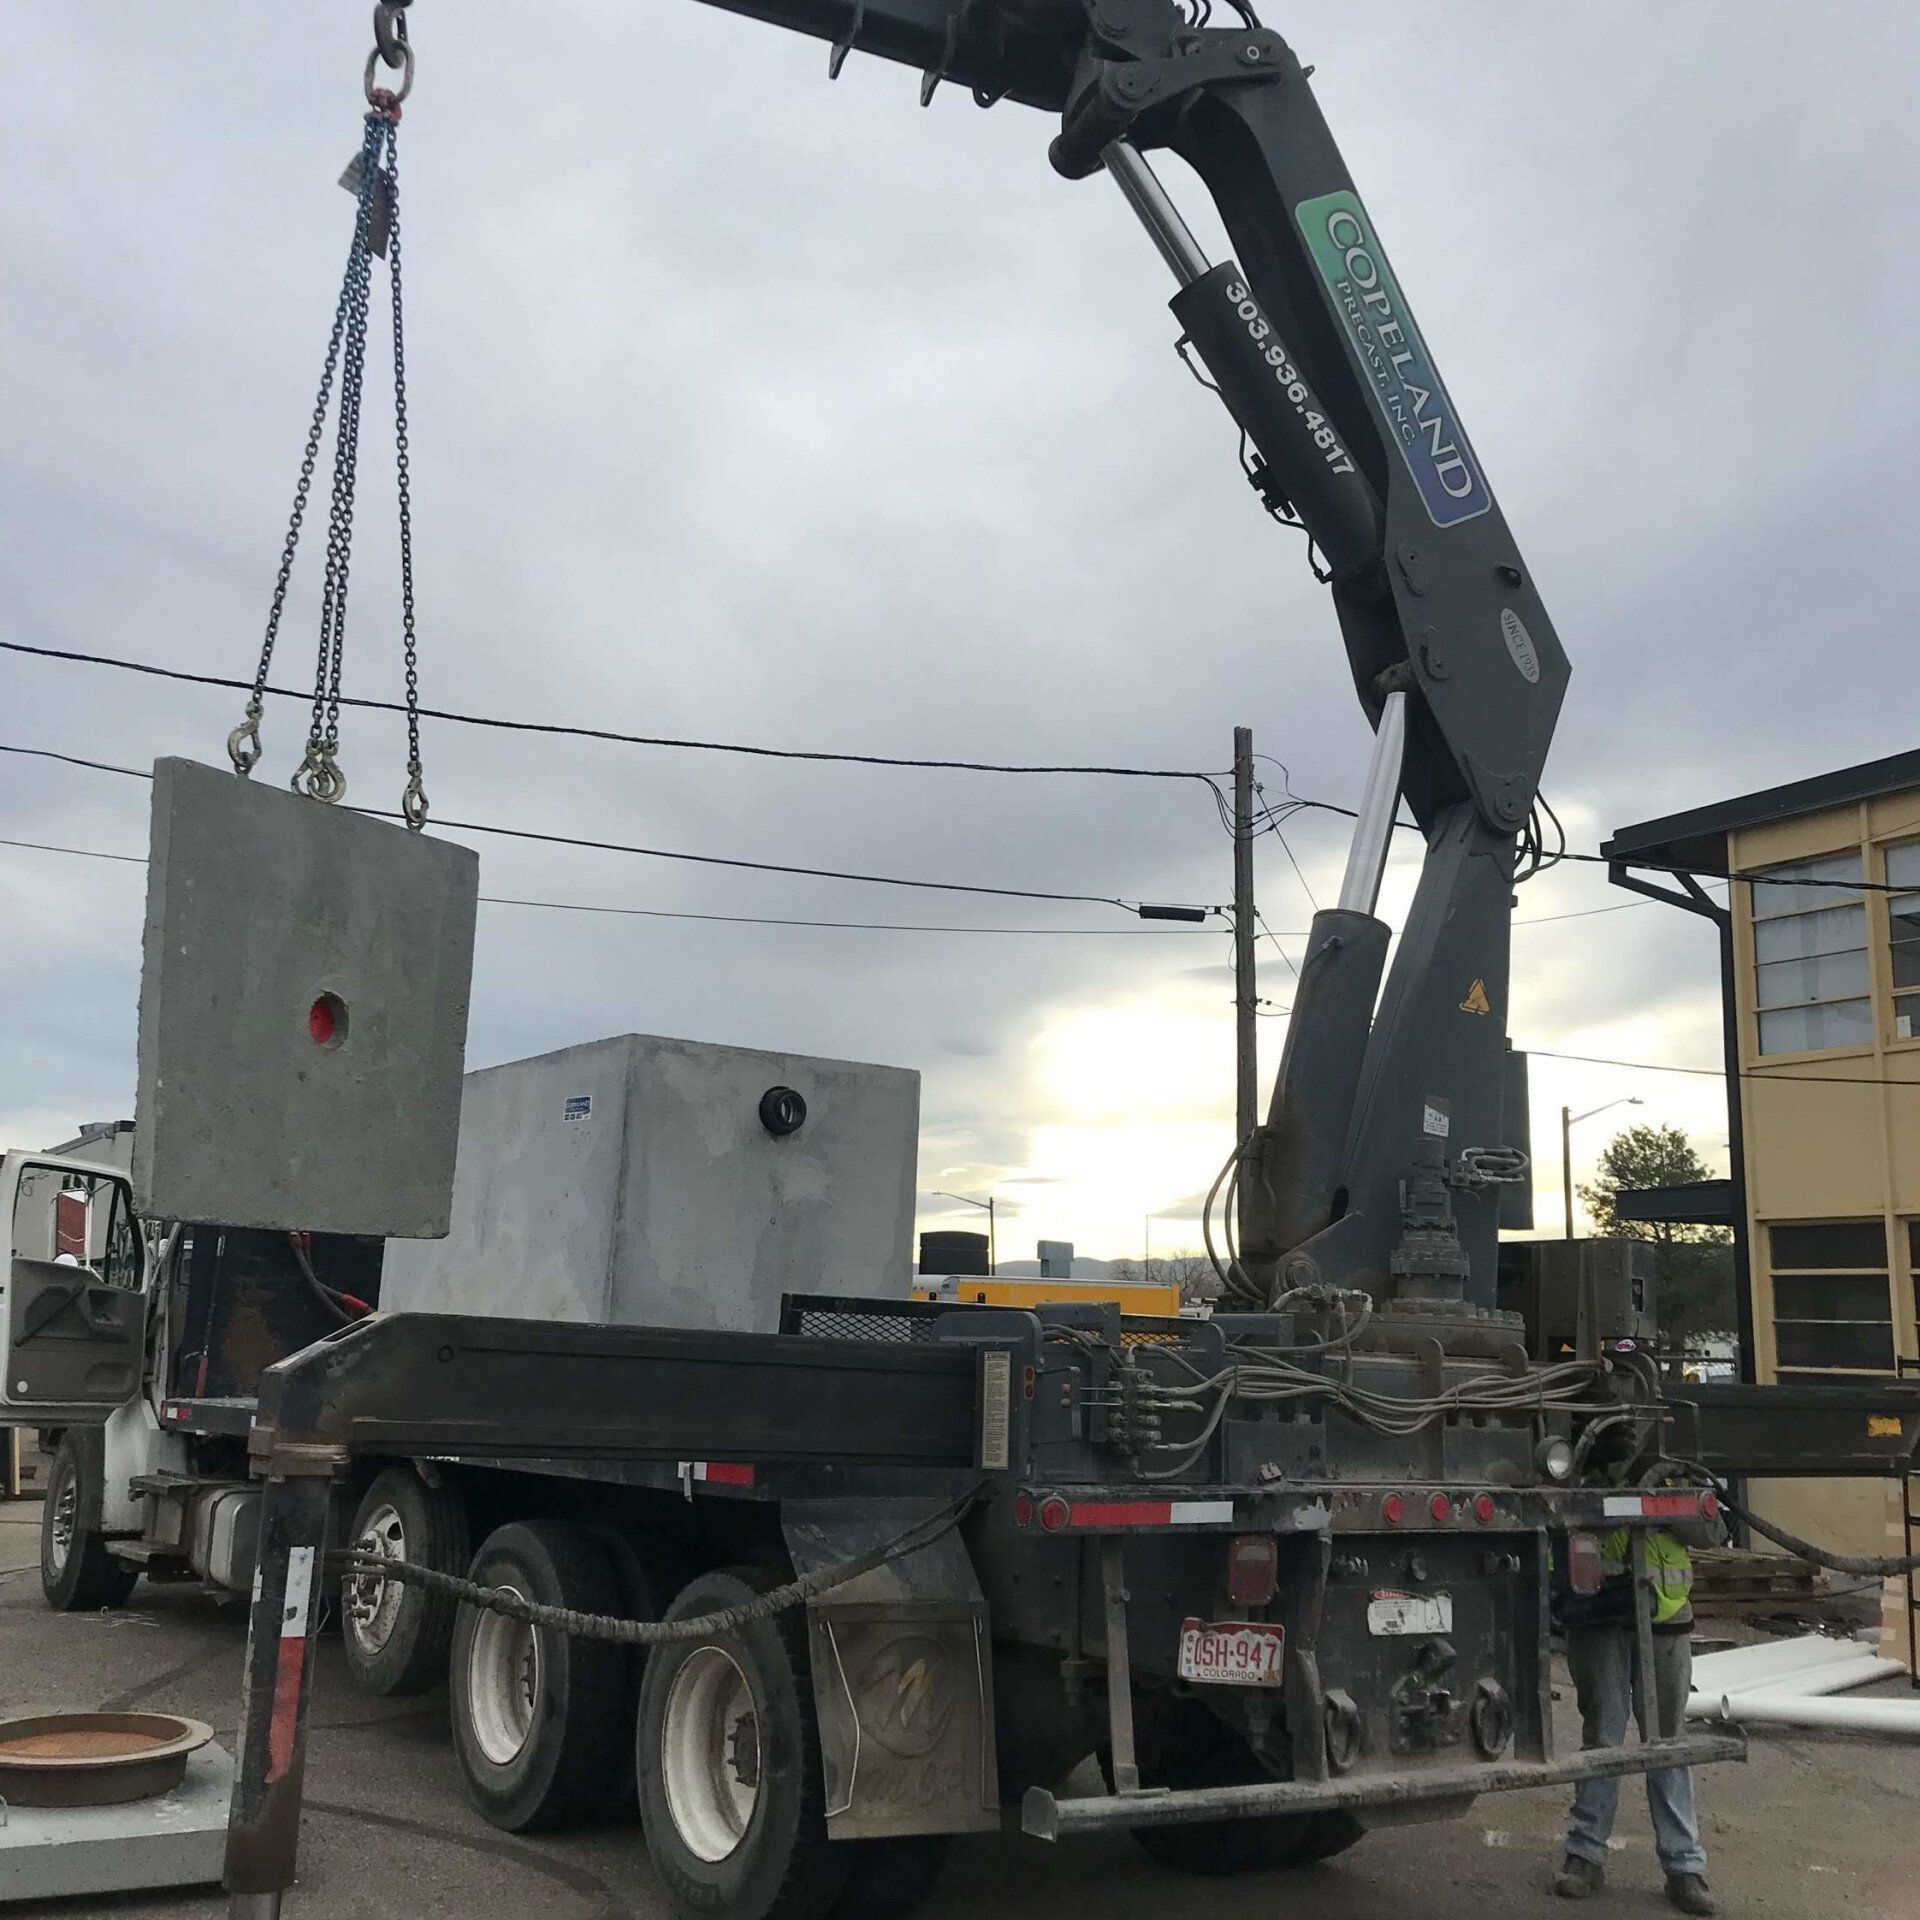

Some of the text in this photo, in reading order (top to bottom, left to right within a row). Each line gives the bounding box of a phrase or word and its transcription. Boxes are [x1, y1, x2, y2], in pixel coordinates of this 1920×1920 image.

[1226, 281, 1355, 475] 303.936.4817
[1328, 211, 1472, 498] COPELAND
[1337, 280, 1419, 446] PRECAST, INC.
[1503, 613, 1525, 650] SINCE
[1203, 1668, 1255, 1680] COLORADO
